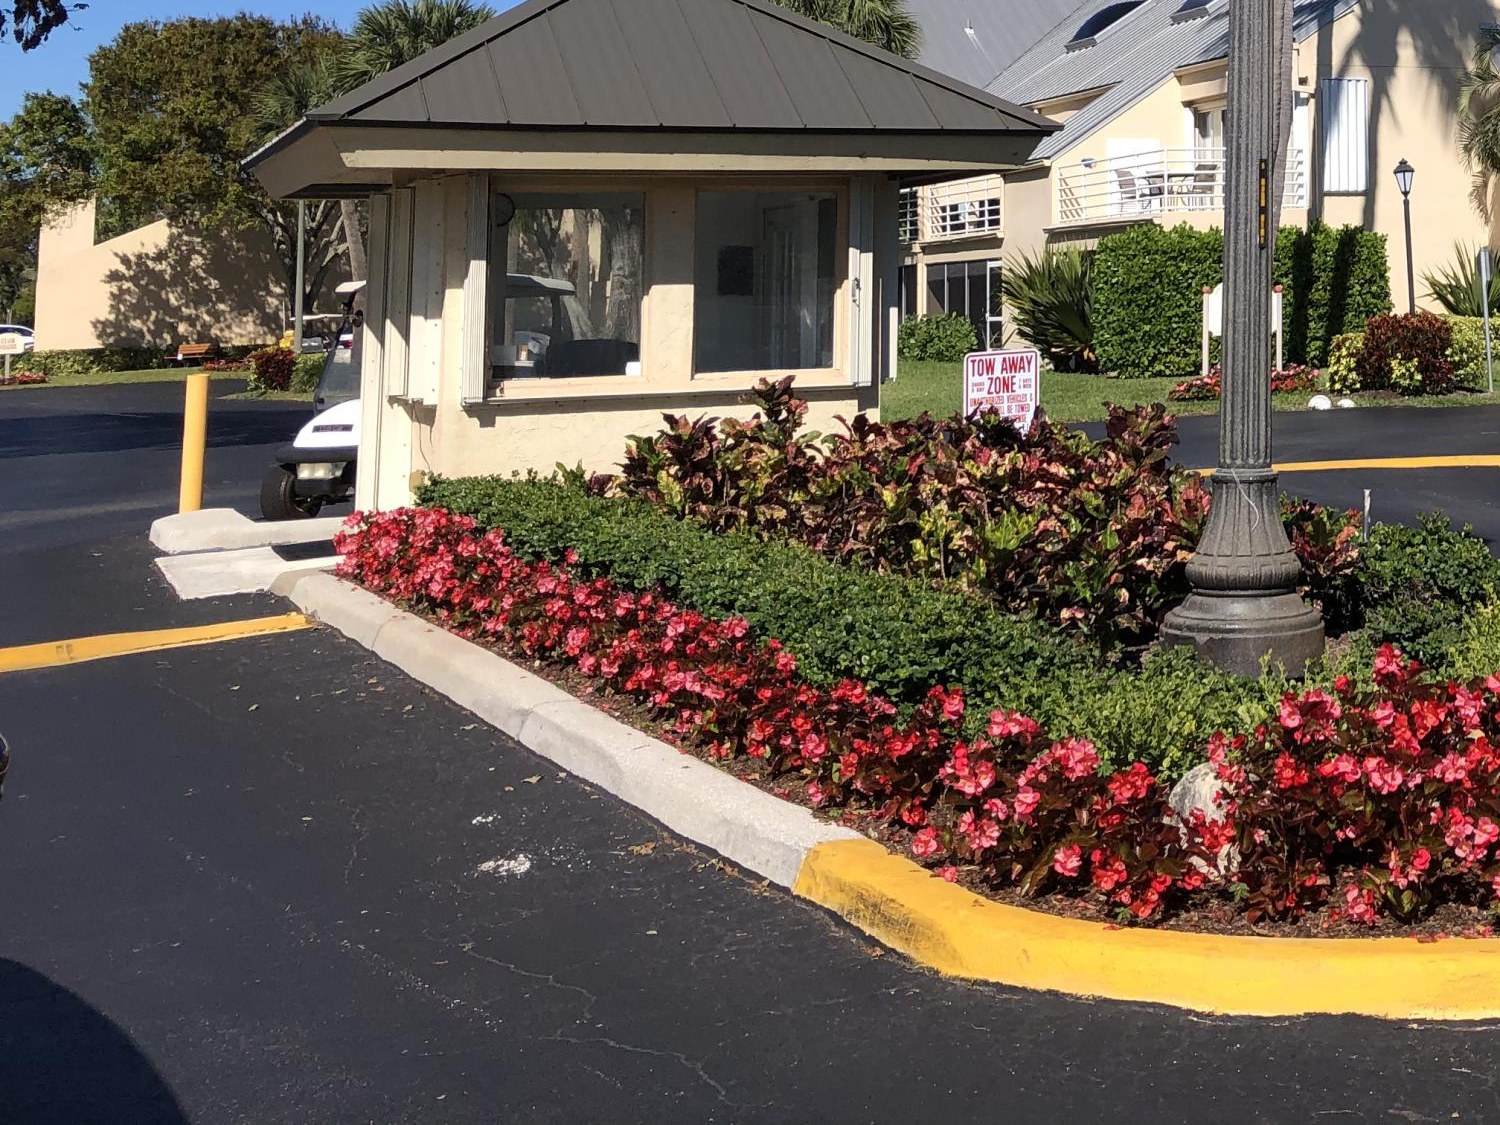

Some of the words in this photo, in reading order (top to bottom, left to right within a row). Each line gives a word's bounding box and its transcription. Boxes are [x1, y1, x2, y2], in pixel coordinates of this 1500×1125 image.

[971, 357, 996, 376] TOW
[1001, 355, 1033, 374] AWAY
[988, 376, 1016, 394] ZONE
